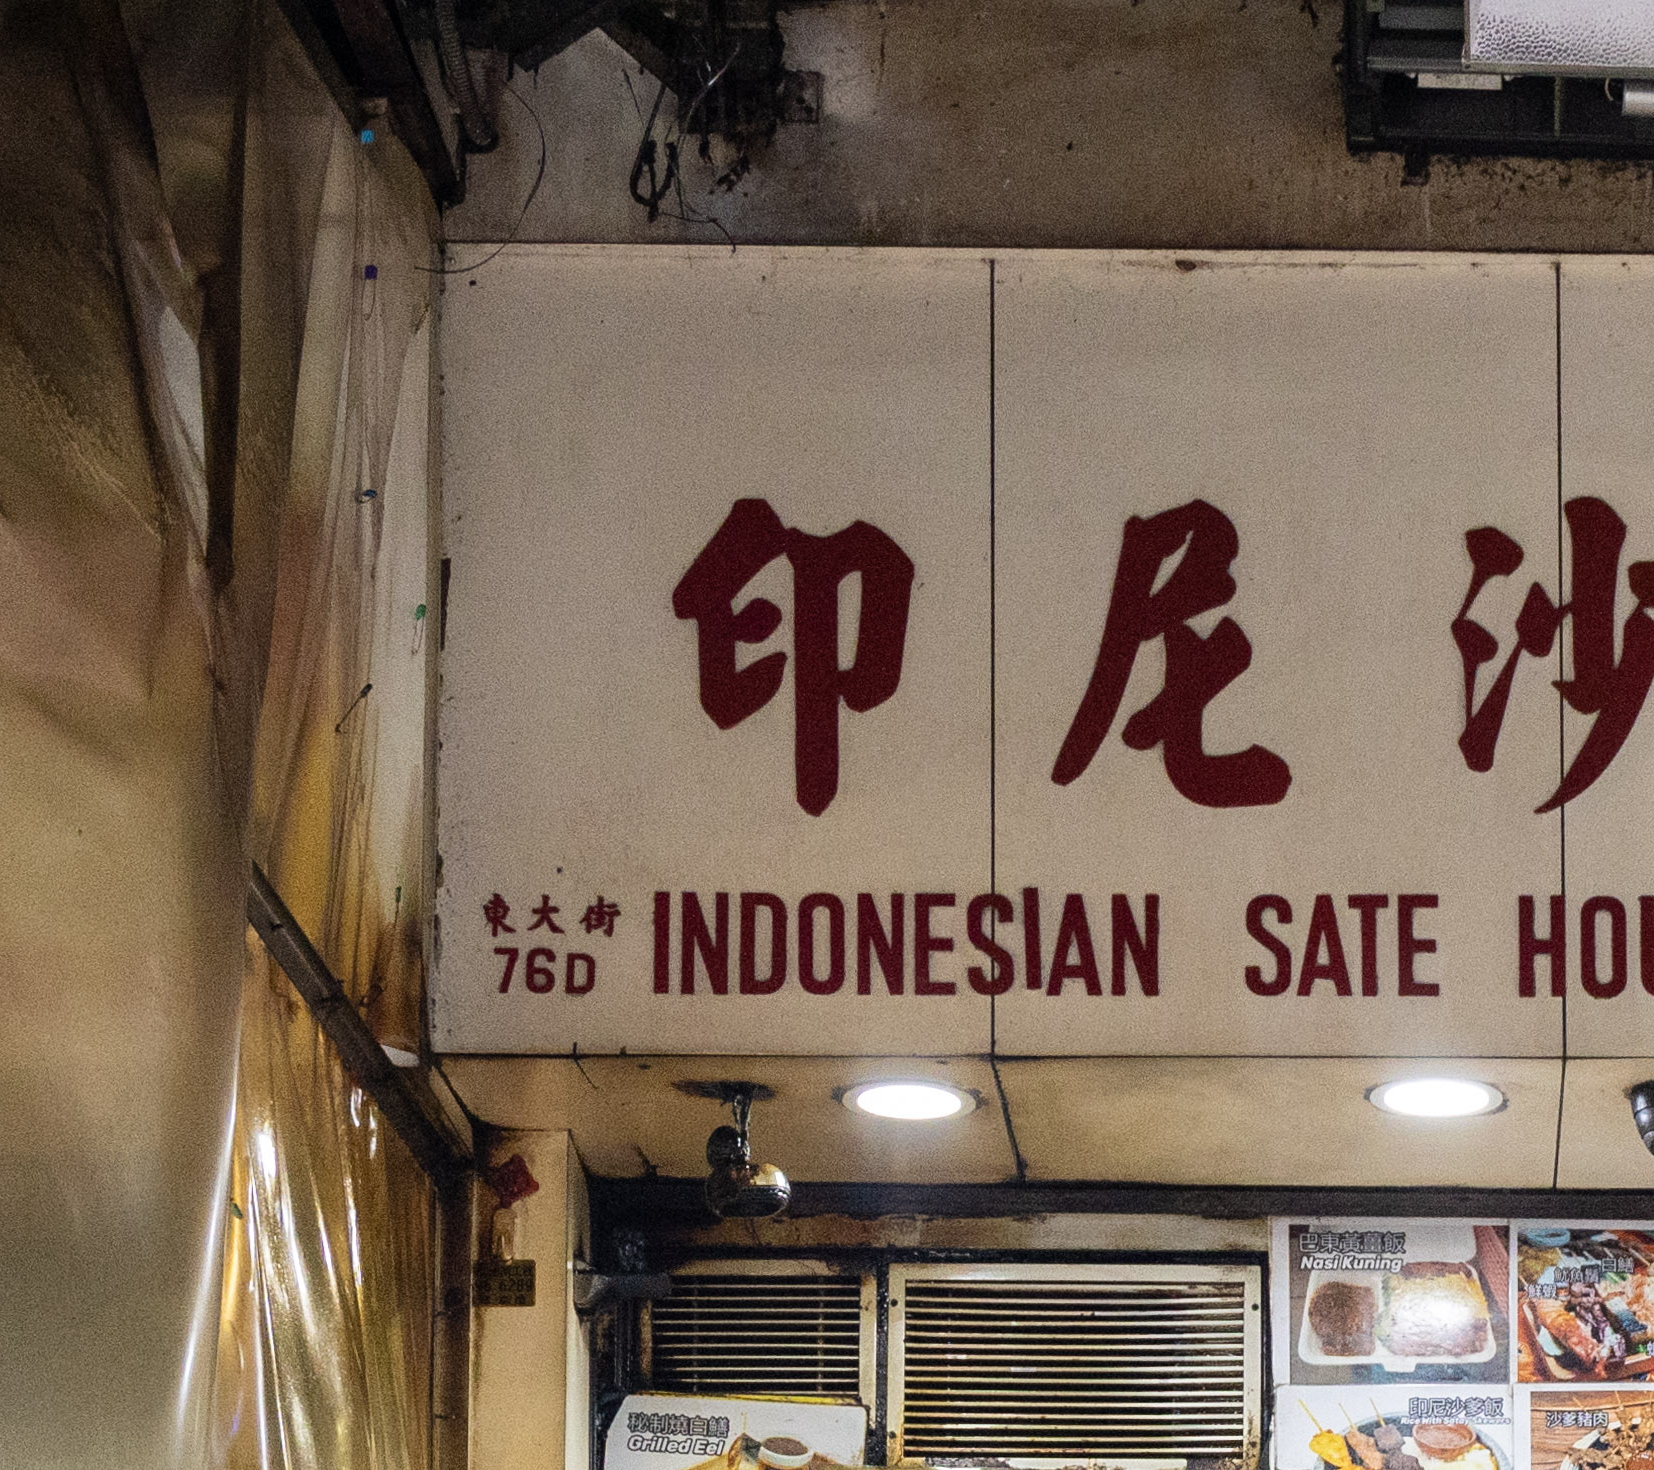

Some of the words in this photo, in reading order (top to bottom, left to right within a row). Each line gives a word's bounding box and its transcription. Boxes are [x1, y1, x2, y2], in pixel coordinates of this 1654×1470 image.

[482, 893, 622, 937] 東大街
[653, 888, 1160, 998] INDONESIAN
[1244, 893, 1439, 998] SATE
[493, 947, 596, 995] 76D
[1300, 1255, 1341, 1272] Nasi
[1342, 1255, 1403, 1276] Kuning
[1408, 1397, 1504, 1418] 印尼沙爹飯
[1546, 1411, 1608, 1428] 沙爹豬肉
[627, 1436, 689, 1456] Grilled
[692, 1438, 724, 1457] Eel
